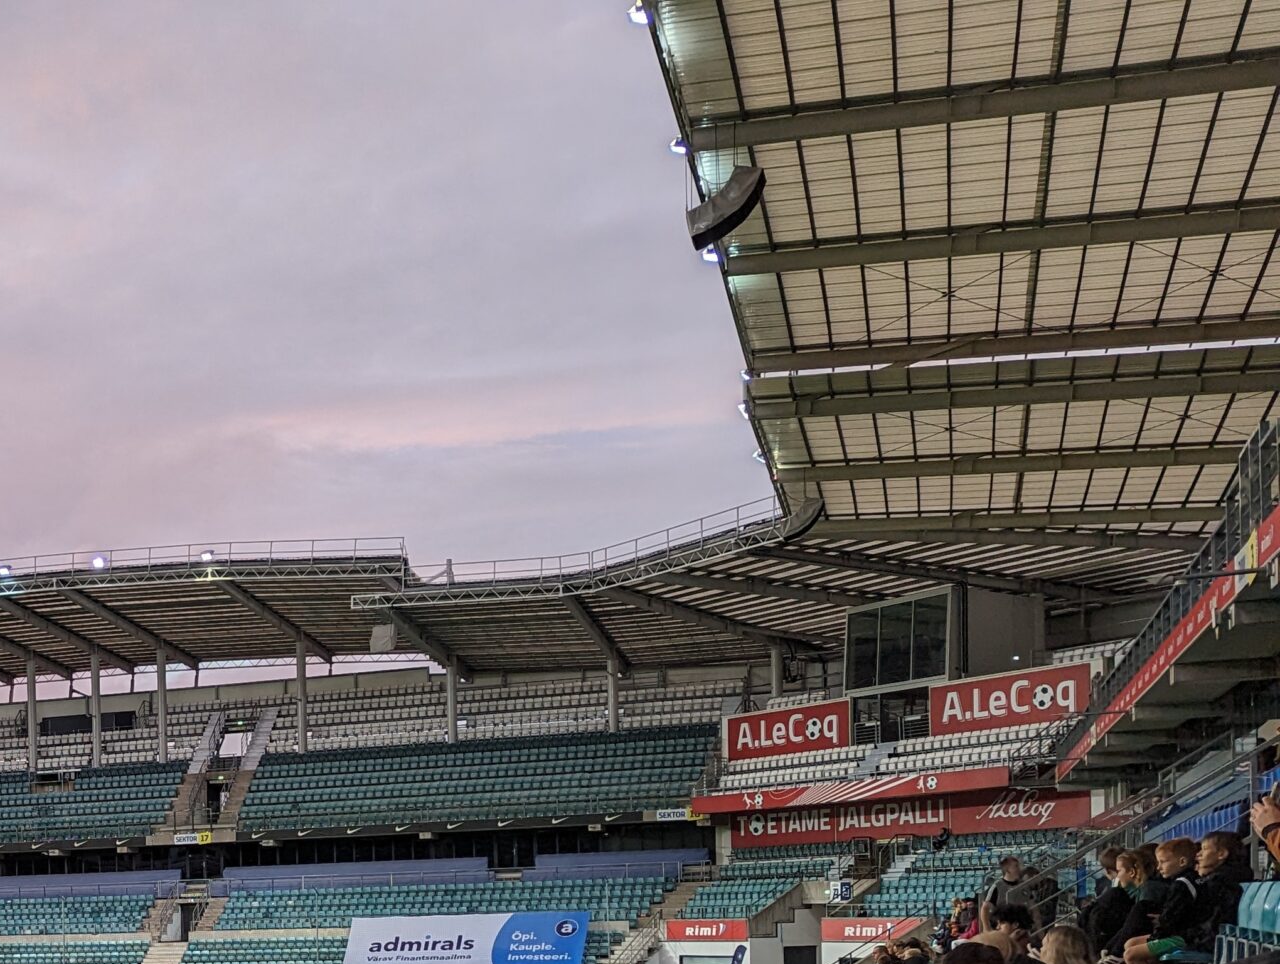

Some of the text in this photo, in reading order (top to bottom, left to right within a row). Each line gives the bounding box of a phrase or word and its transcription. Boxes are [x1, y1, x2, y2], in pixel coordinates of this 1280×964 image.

[658, 810, 686, 819] SEKTOR
[839, 799, 945, 831] JALGPALLI
[175, 834, 209, 843] SEKTOR 17
[511, 930, 537, 943] Õpi.
[368, 935, 475, 953] admirals
[509, 943, 556, 954] Kauple.
[367, 953, 472, 963] Värav Finantsmaailma
[507, 952, 571, 962] Investeeri.
